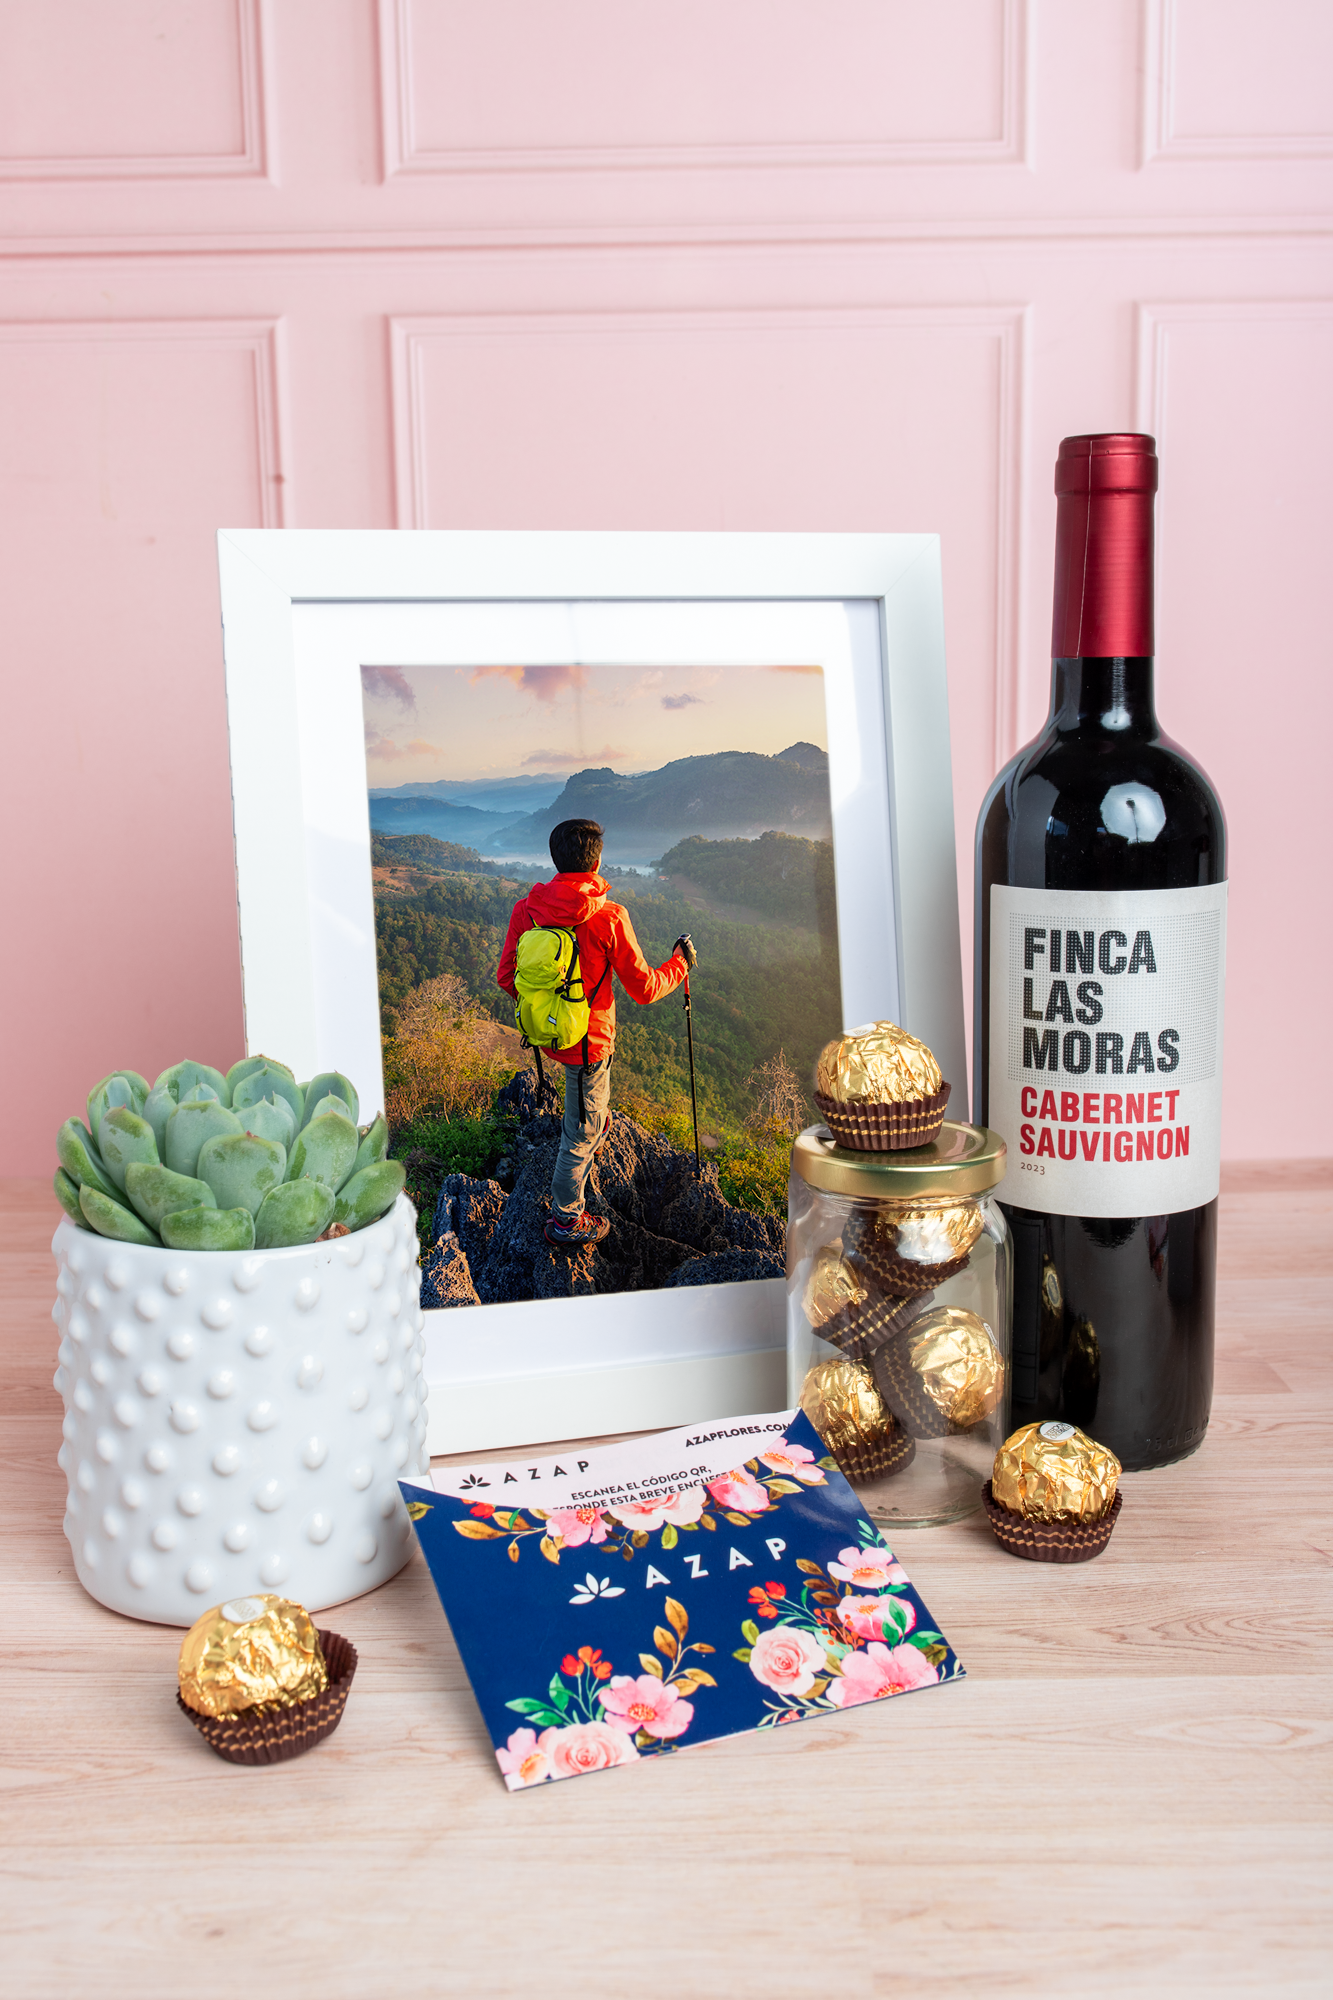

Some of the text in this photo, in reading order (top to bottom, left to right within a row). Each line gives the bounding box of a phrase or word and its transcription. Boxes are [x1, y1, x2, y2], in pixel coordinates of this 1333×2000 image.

[1024, 927, 1157, 975] FINCA
[1023, 977, 1104, 1025] LAS
[1022, 1027, 1180, 1074] MORAS
[1020, 1086, 1180, 1124] CABERNET
[1019, 1123, 1190, 1163] SAUVIGNON
[1020, 1161, 1045, 1176] 2023
[503, 1460, 589, 1484] AZAP
[571, 1465, 712, 1500] ESCANEA EL CÓDIGO QR,
[610, 1494, 638, 1506] ESTA
[639, 1485, 676, 1500] BREVE
[645, 1537, 787, 1589] AZAP
